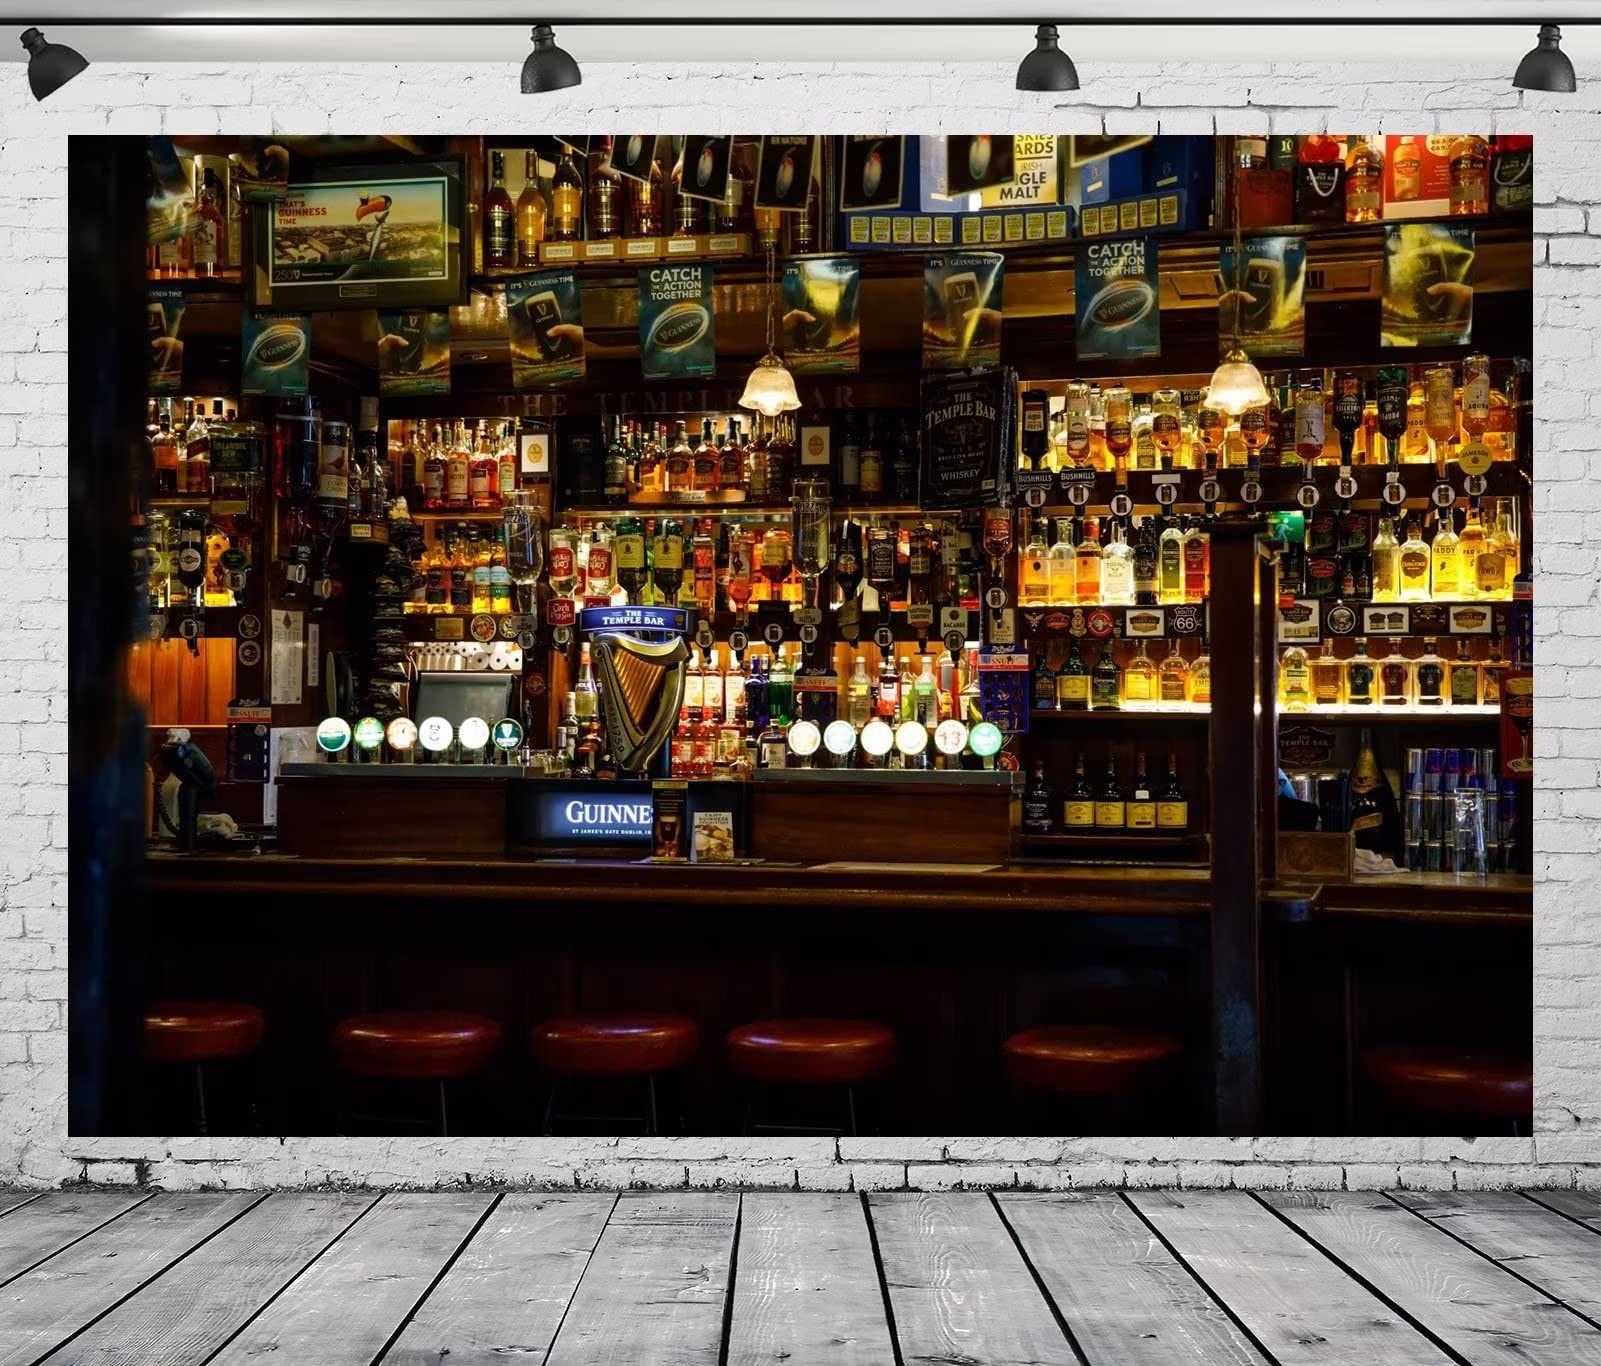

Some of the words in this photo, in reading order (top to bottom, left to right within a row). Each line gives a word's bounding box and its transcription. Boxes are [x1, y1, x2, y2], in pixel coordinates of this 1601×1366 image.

[1020, 162, 1043, 171] IRISH
[1000, 186, 1041, 200] MALT
[278, 207, 327, 217] GUINNESS
[279, 217, 297, 225] TIME
[1087, 241, 1145, 258] CATCH
[930, 259, 943, 267] IT'S
[950, 257, 982, 266] GUINNESS
[982, 256, 999, 265] TIME
[1102, 255, 1145, 267] ACTION
[274, 269, 293, 281] 250
[650, 267, 702, 283] CATCH
[786, 267, 799, 275] IT'S
[1088, 265, 1145, 277] TOGETHER
[510, 280, 523, 290] IT'S
[529, 277, 560, 288] GUINNESS
[559, 275, 575, 285] TIME
[663, 280, 702, 291] ACTION
[168, 290, 182, 298] TIME
[650, 290, 702, 301] TOGETHER
[1107, 295, 1146, 315] GUINNESS
[668, 317, 702, 337] GUINNESS
[267, 339, 300, 357] GUINNESS
[953, 391, 973, 403] THE
[496, 394, 569, 416] THE
[925, 402, 974, 430] TEMPLE
[974, 400, 997, 422] BAR
[1461, 450, 1489, 458] JAMESON
[940, 468, 981, 481] WHISKEY
[1018, 474, 1053, 483] BUSHMILLS
[1060, 471, 1096, 481] BUSHMILLS
[602, 616, 643, 625] TEMPLE
[644, 616, 664, 626] BAR
[1176, 617, 1194, 630] 66
[565, 800, 653, 824] GUINNE
